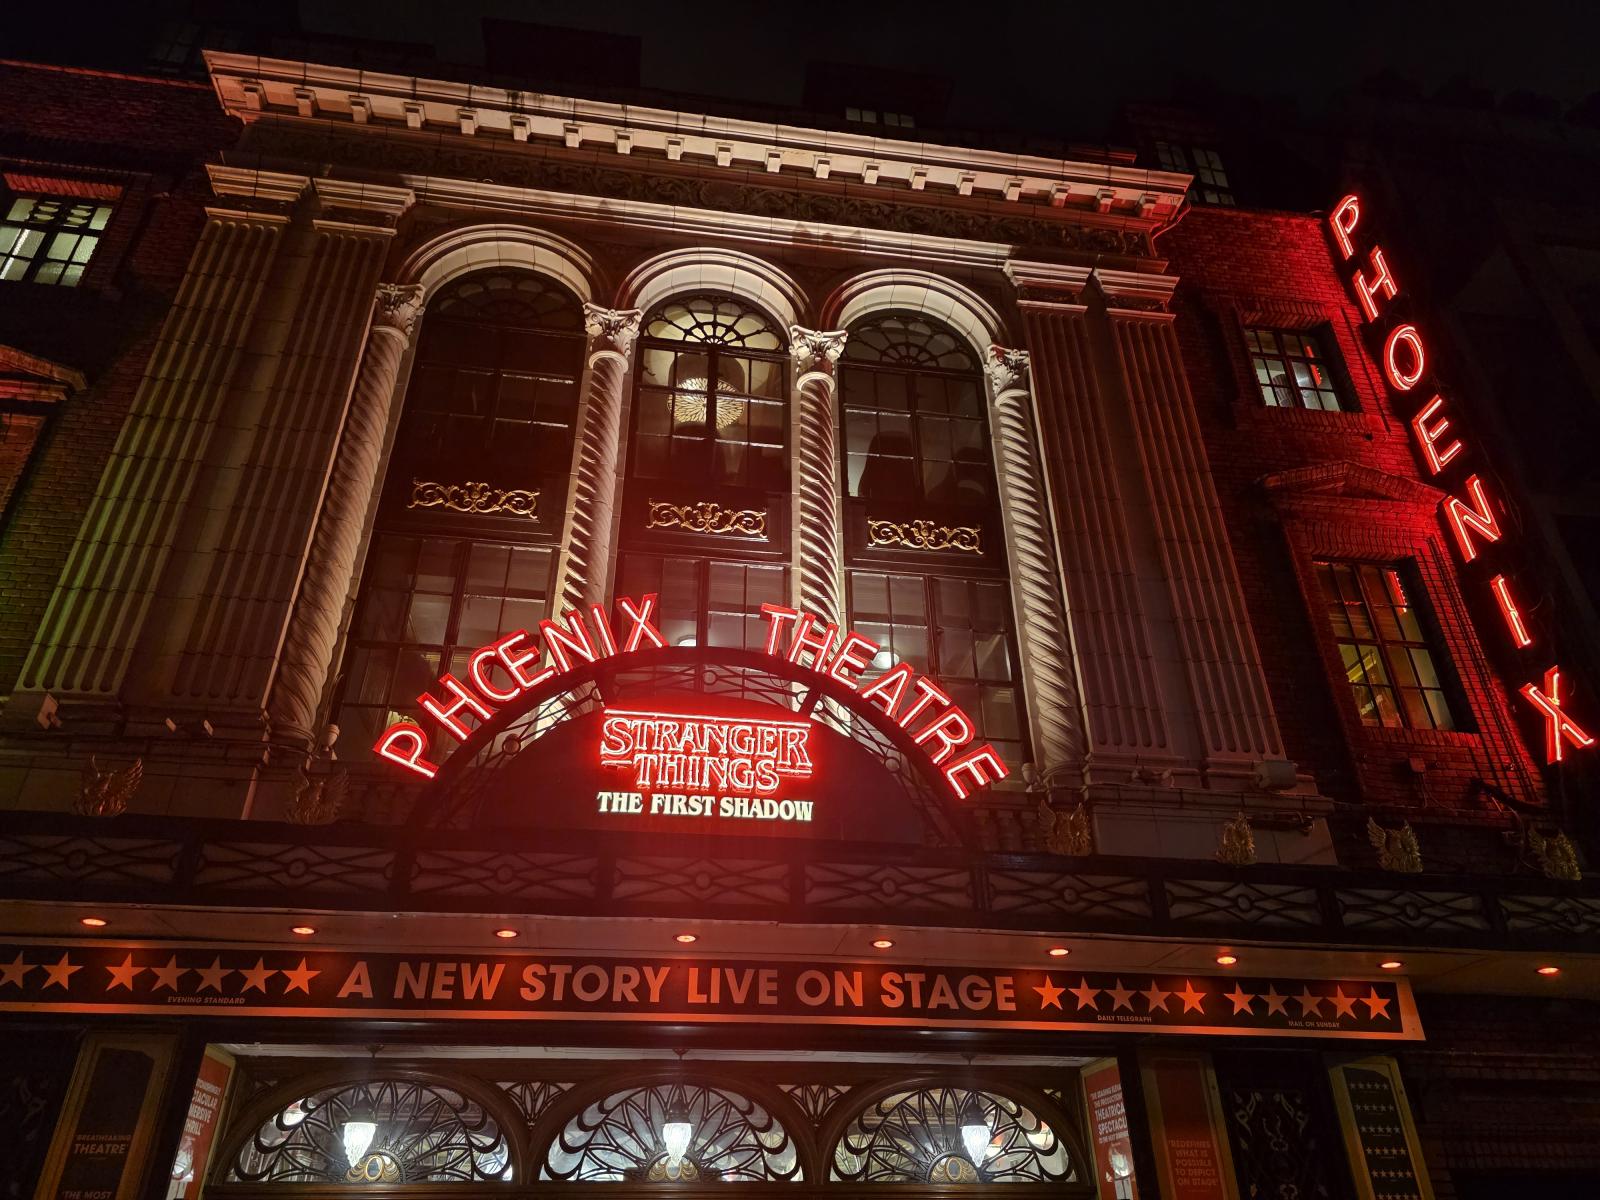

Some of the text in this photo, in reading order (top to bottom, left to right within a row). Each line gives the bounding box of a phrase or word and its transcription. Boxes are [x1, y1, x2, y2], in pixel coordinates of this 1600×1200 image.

[1330, 194, 1596, 766] PHOENIX
[760, 602, 1011, 801] THEATRE
[599, 717, 813, 768] STRANGER
[633, 753, 780, 792] THINGS
[596, 791, 814, 822] THE FIRST SHADOW
[336, 962, 1019, 1012] A NEW STORY LIVE ON STAGE
[167, 995, 246, 1005] EVENING STANDARD
[1116, 1015, 1152, 1023] TELEGRAPH
[1175, 1148, 1209, 1158] WHAT IS
[1175, 1158, 1212, 1167] POSSIBLE
[1175, 1168, 1216, 1177] TO DEPICT
[1177, 1177, 1190, 1186] ON
[83, 1191, 112, 1200] MOST
